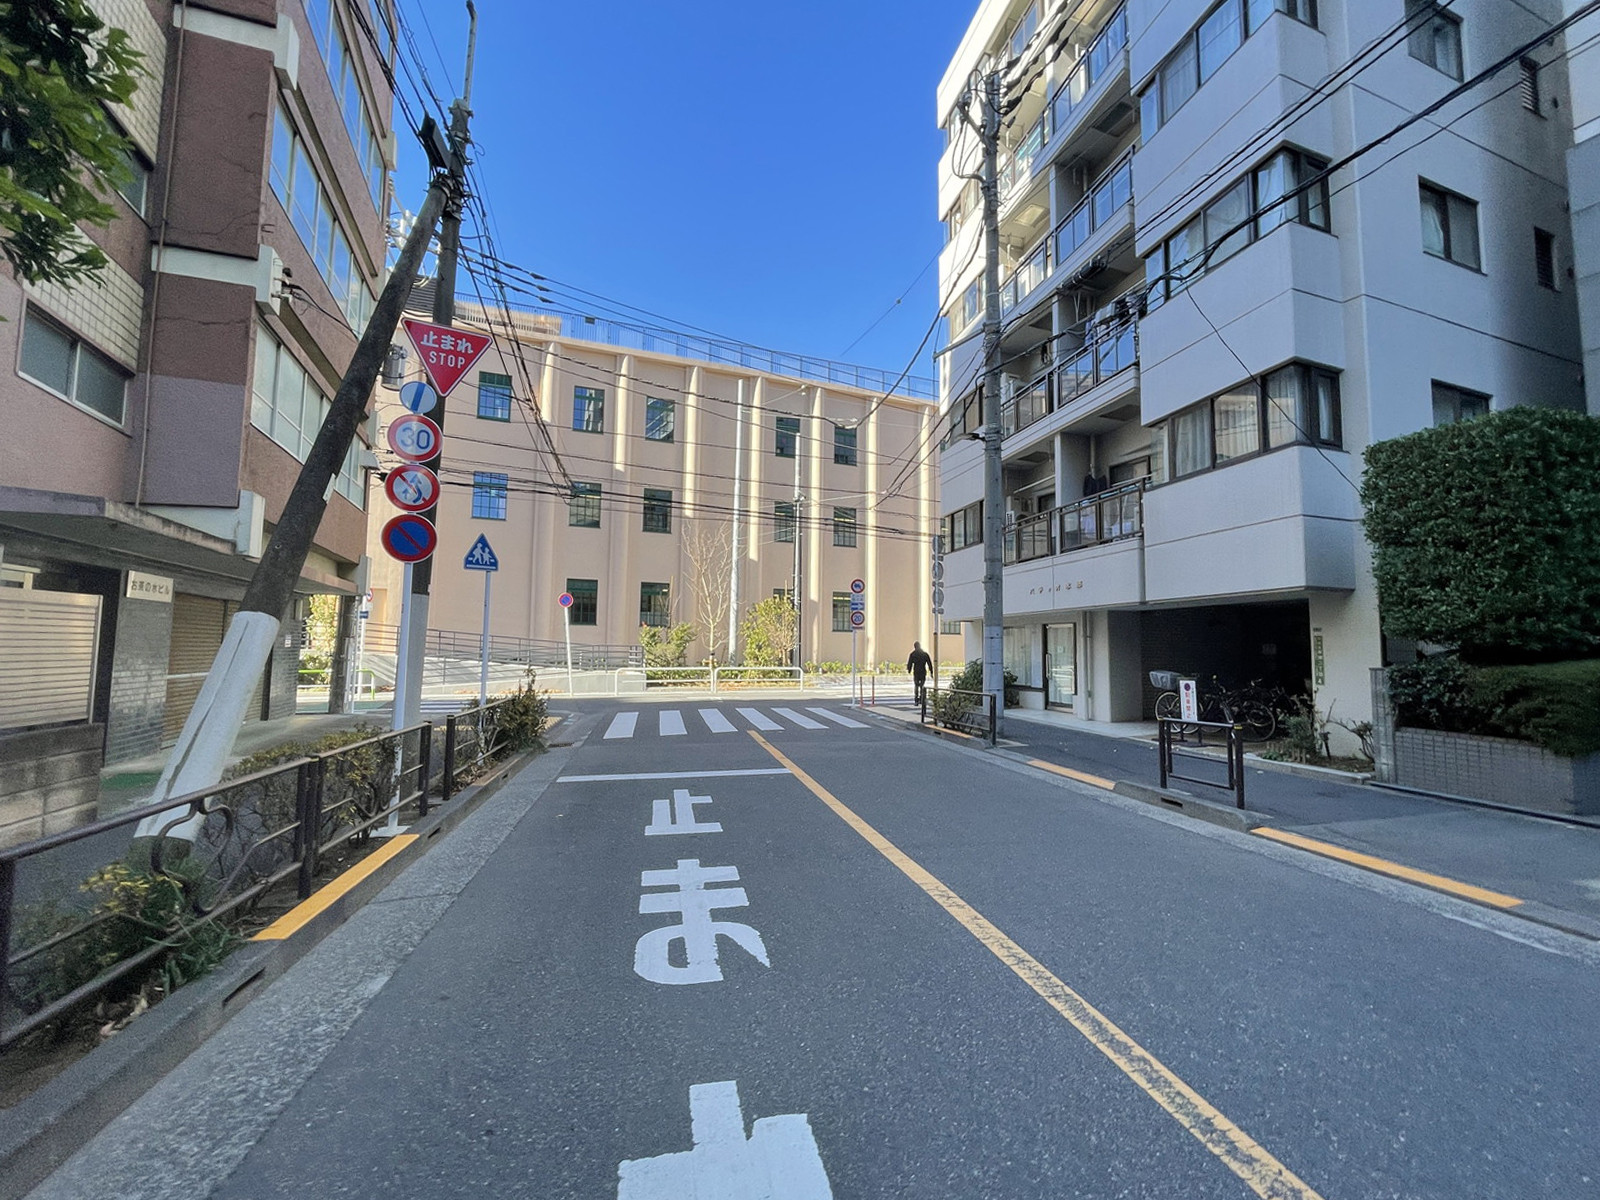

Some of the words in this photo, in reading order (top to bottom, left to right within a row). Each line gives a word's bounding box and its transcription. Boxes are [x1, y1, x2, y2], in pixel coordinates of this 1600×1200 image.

[420, 331, 474, 354] 止まれ
[429, 350, 466, 369] STOP
[401, 426, 431, 450] 30
